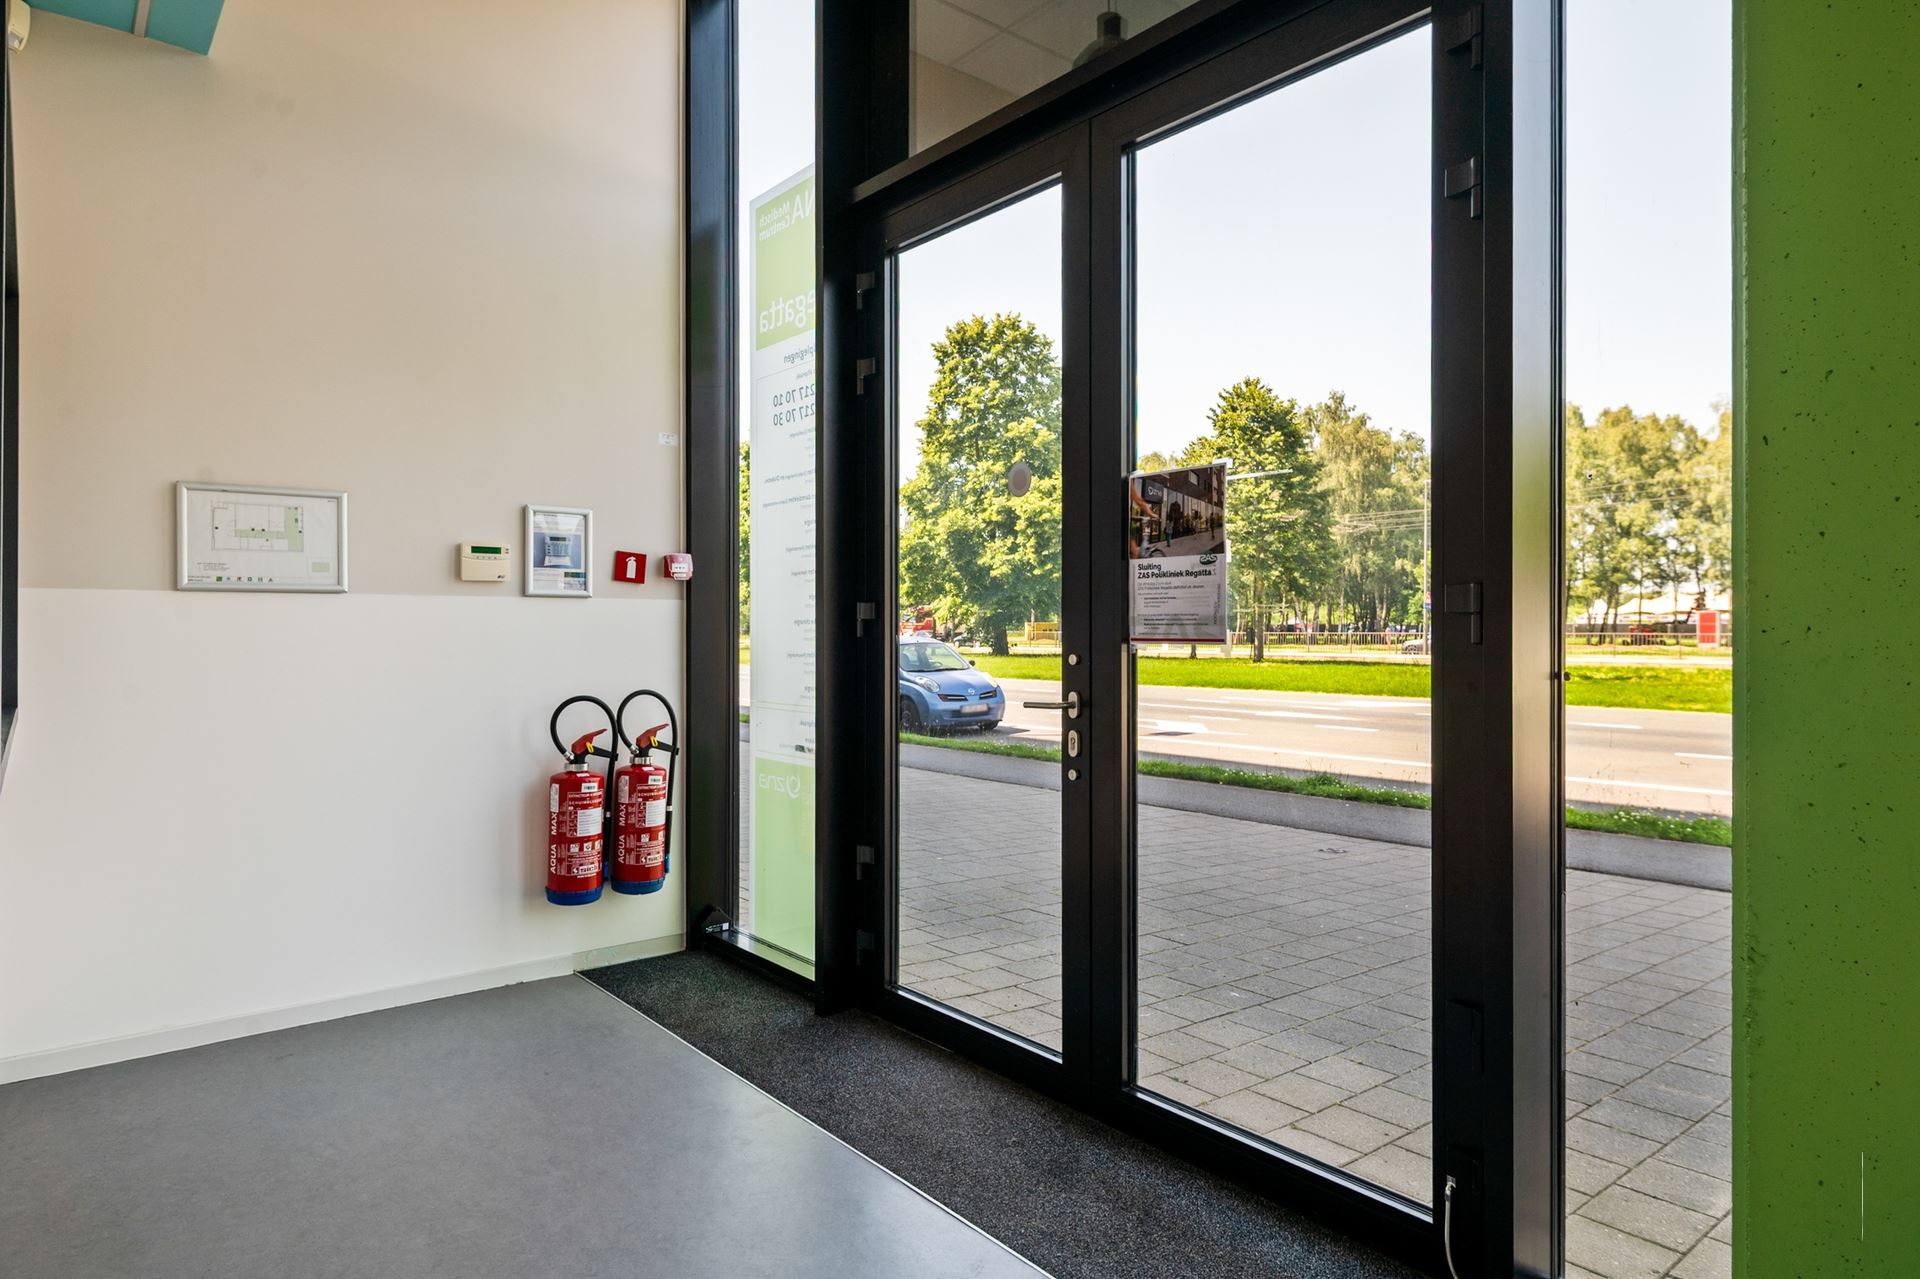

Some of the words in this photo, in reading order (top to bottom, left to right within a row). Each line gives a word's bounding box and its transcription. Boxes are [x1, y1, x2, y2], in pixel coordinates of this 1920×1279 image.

[1200, 554, 1217, 562] ZAS
[1137, 563, 1162, 571] Sluiting
[1151, 570, 1184, 578] Polikliniek
[1185, 569, 1212, 578] Regatta
